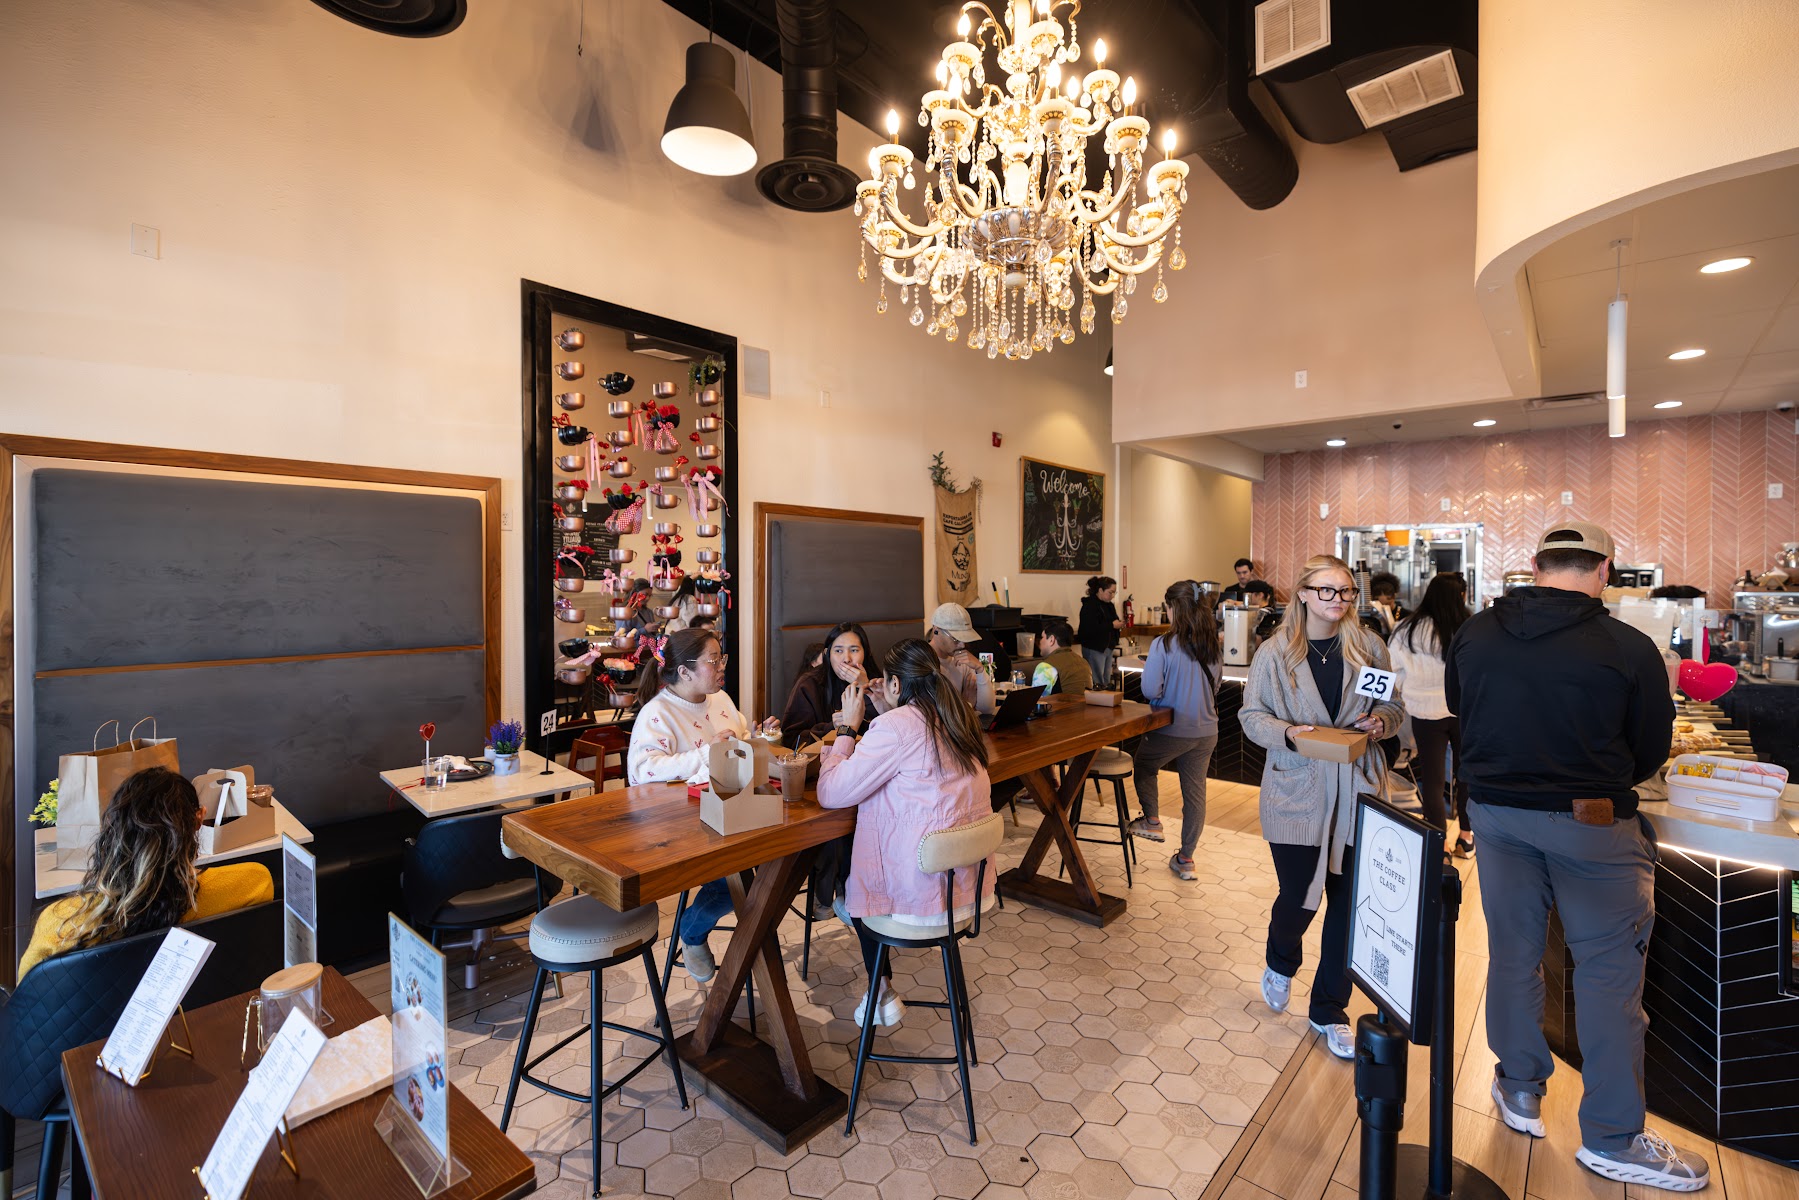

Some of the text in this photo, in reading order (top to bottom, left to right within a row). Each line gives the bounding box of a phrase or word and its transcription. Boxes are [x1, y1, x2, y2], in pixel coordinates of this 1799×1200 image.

[1040, 469, 1090, 498] Welcome
[1361, 672, 1389, 694] 25
[543, 714, 554, 731] 24
[1373, 858, 1383, 871] THE
[1384, 866, 1405, 885] COFFEE
[1379, 876, 1396, 892] CLASS
[1386, 925, 1413, 951] LINE STARTS
[1391, 940, 1406, 956] THERE
